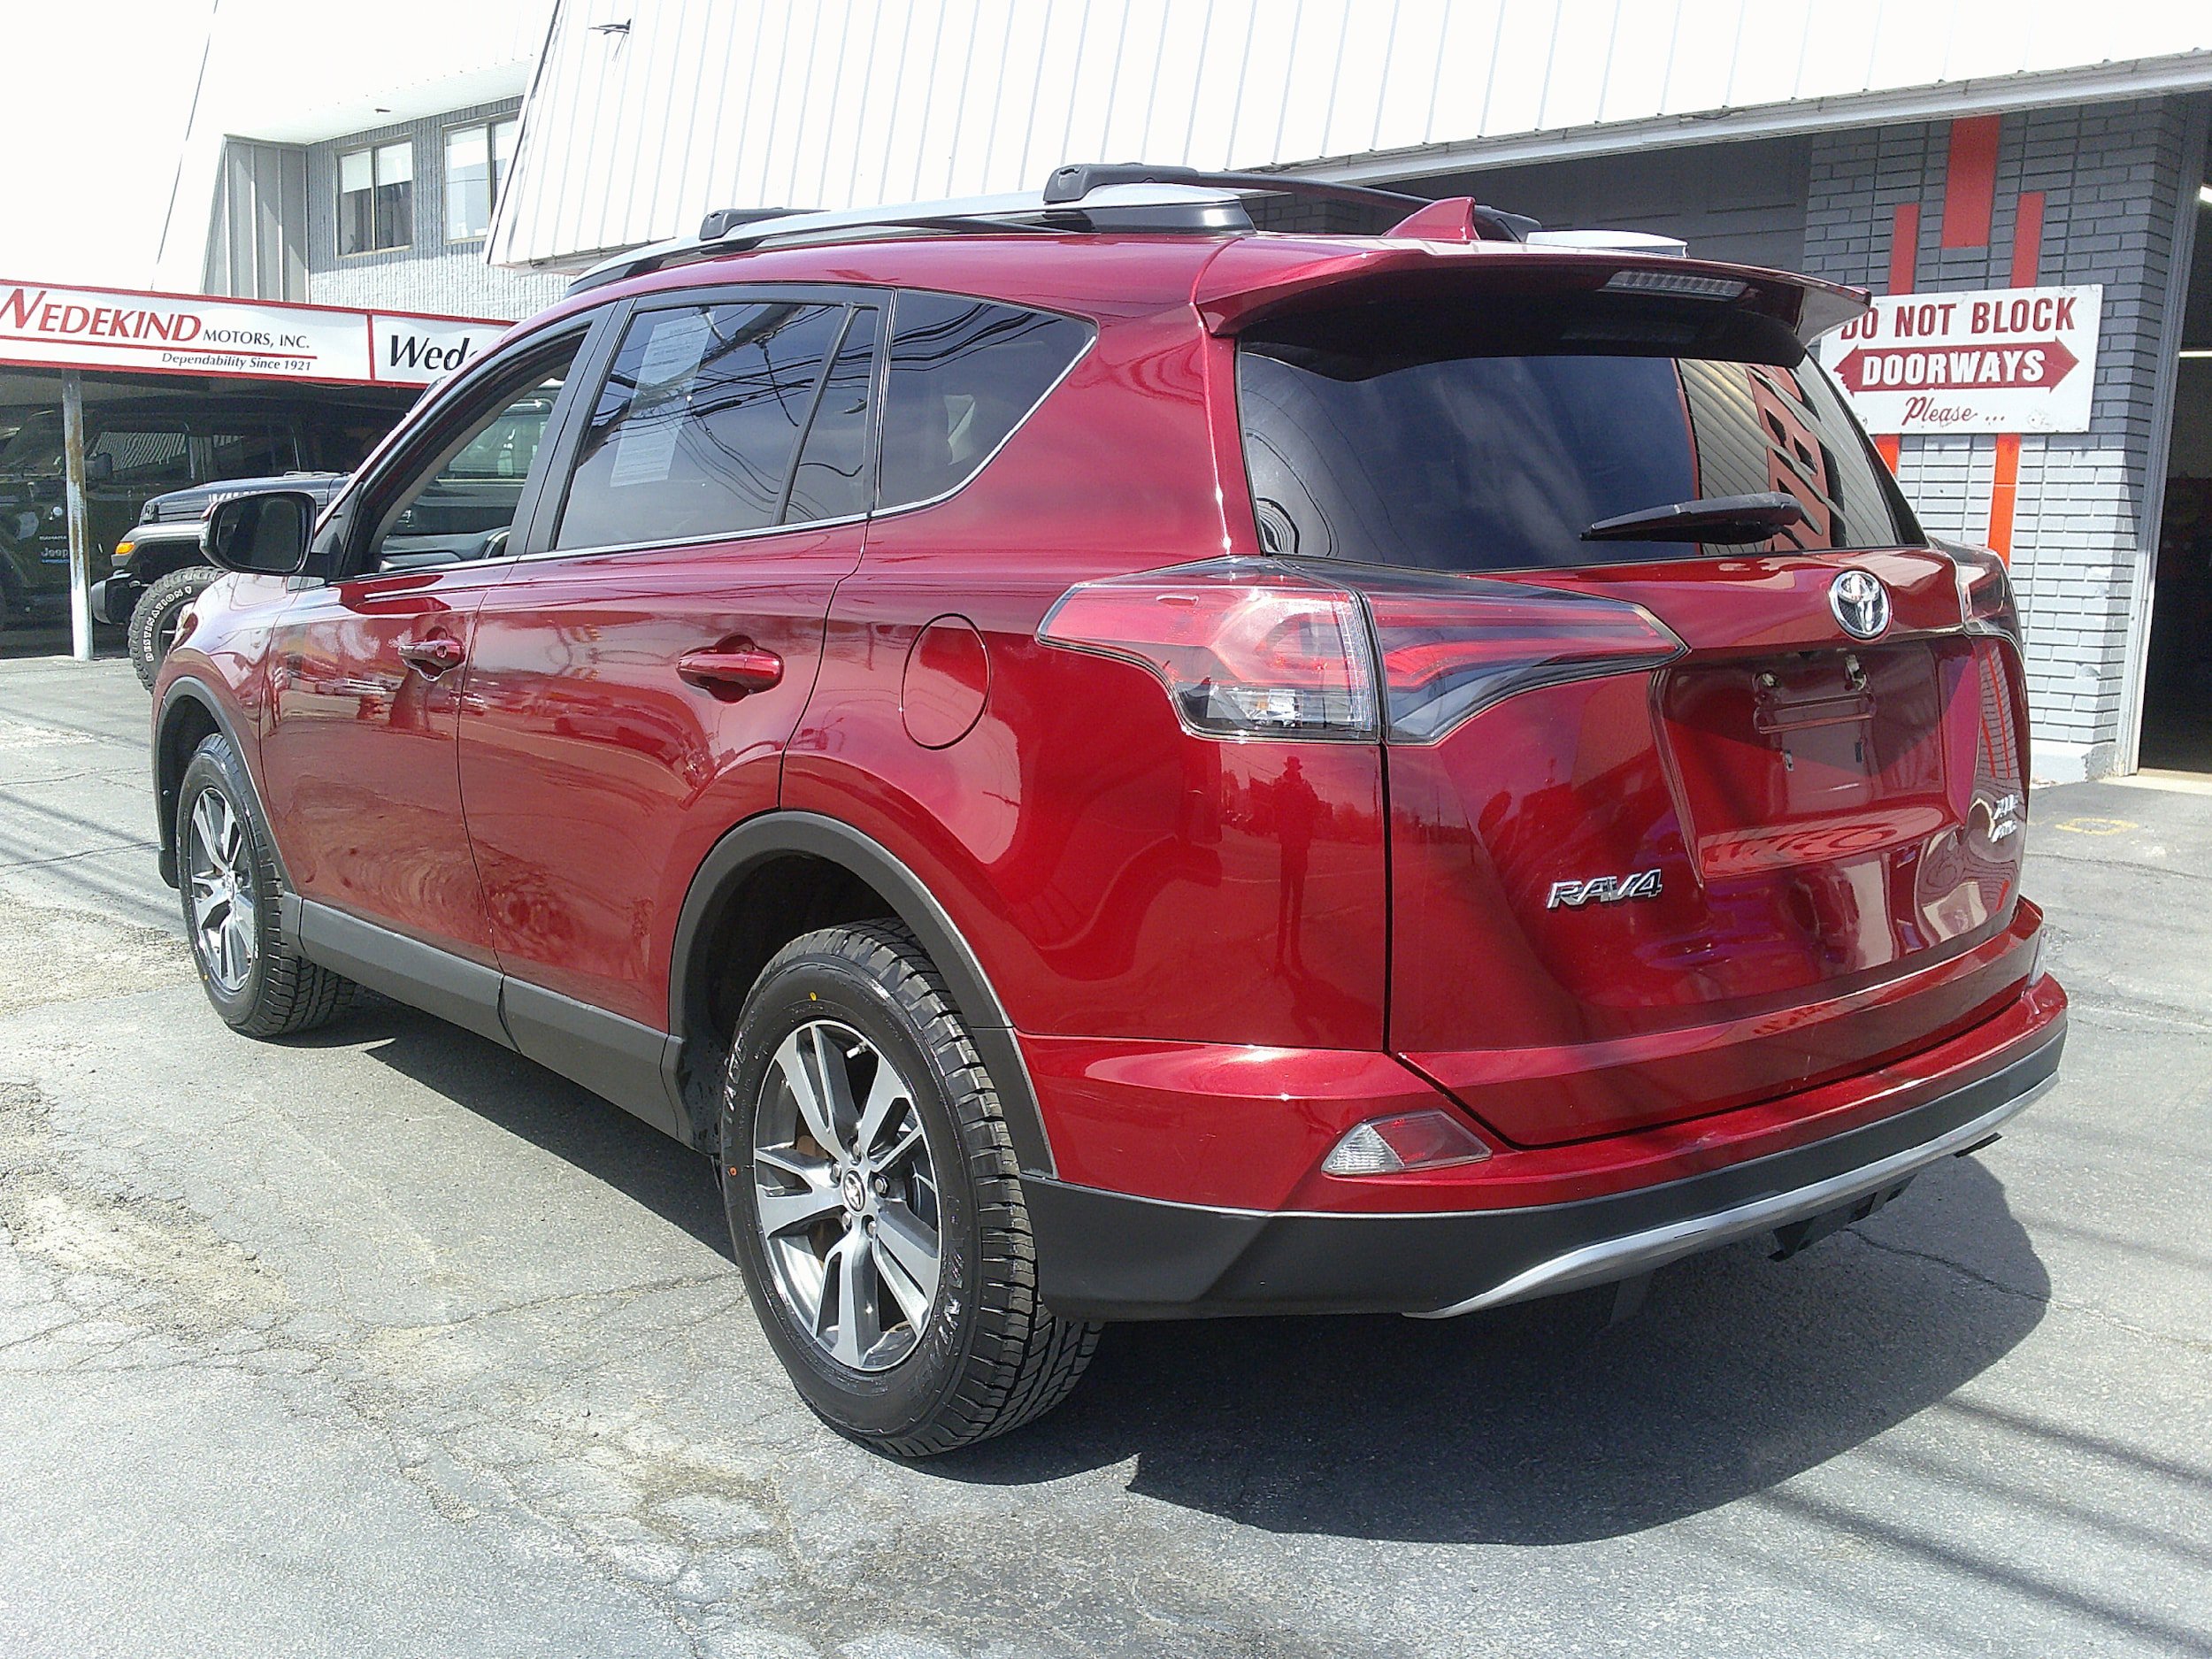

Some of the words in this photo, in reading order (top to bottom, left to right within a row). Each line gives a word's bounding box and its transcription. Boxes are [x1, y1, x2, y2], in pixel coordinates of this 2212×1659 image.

[1841, 306, 1879, 341] DO
[1894, 303, 1957, 338] NOT
[1971, 296, 2078, 334] BLOCK
[203, 329, 274, 348] MOTORS,
[280, 334, 311, 349] INC.
[389, 334, 479, 371] Wed
[162, 352, 247, 370] Dependability
[250, 357, 281, 370] Since
[284, 360, 311, 372] 1921
[1862, 349, 2047, 387] DOORWAYS
[1901, 396, 1978, 426] Please
[142, 588, 184, 663] DESTINATION
[1547, 868, 1663, 910] RAV4
